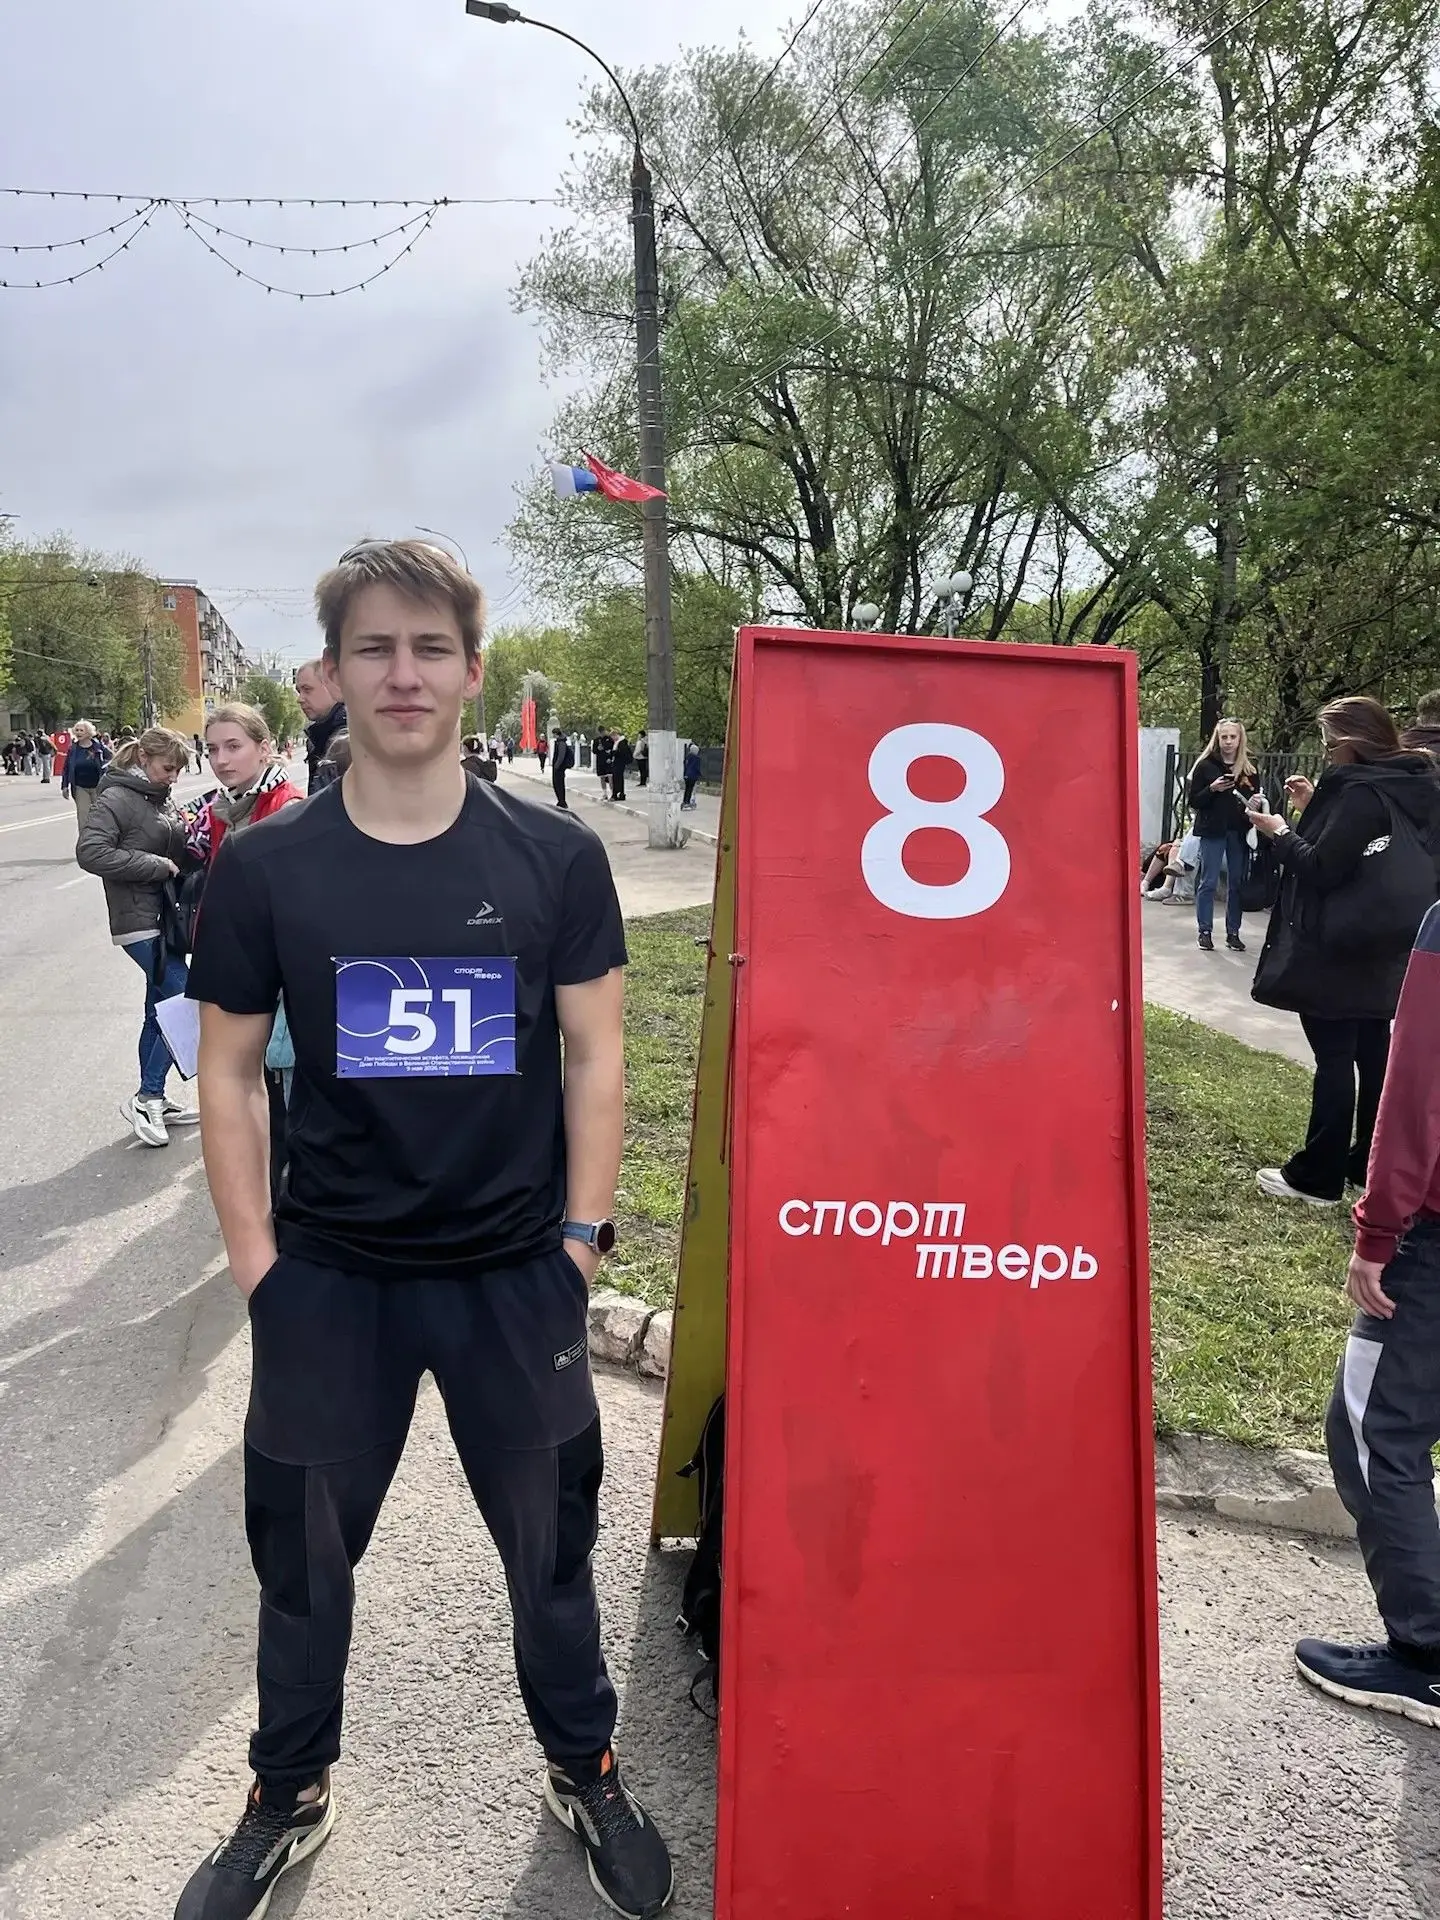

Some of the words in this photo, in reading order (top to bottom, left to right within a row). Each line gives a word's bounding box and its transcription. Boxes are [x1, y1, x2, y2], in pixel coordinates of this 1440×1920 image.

[58, 735, 66, 744] 6
[861, 722, 1011, 919] 8
[466, 917, 504, 925] DEMIX
[383, 988, 472, 1055] 51
[778, 1199, 967, 1246] спорт
[915, 1243, 1099, 1289] тверь
